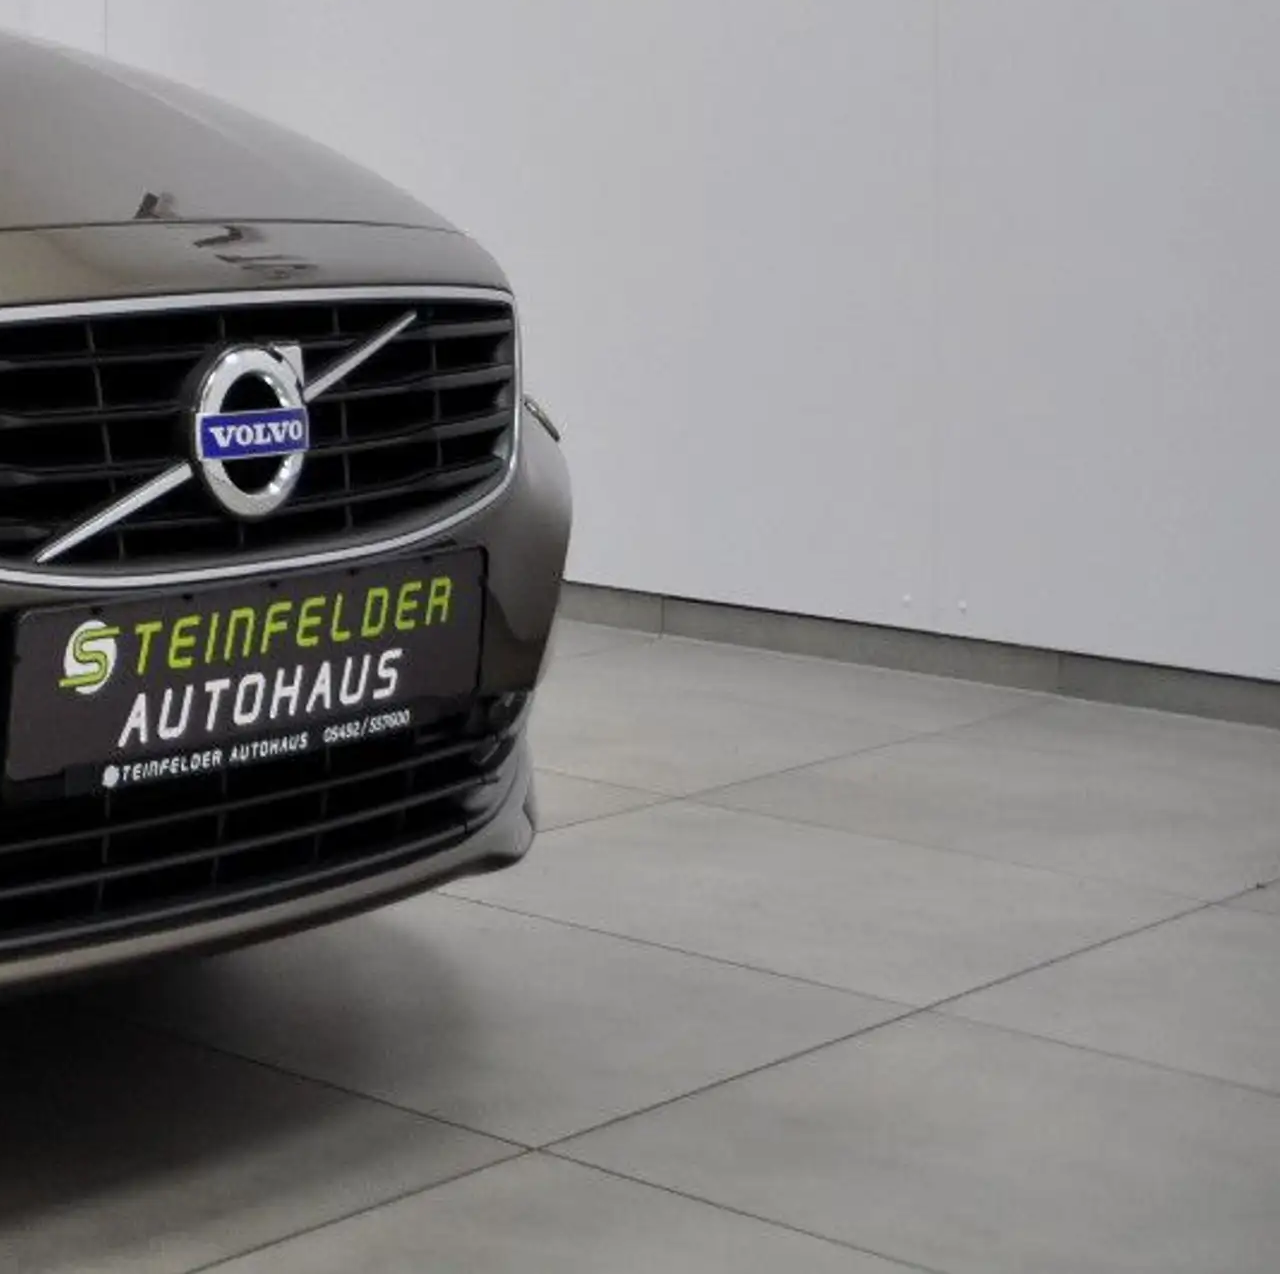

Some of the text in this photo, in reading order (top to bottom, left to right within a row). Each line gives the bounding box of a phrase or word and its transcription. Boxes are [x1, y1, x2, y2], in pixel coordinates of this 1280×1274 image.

[208, 417, 304, 449] VOLVO
[59, 576, 453, 689] STEINFELDER
[117, 648, 403, 747] AUTOHAUS
[102, 749, 223, 788] TEINFELDER
[228, 731, 309, 764] AUTOHAUS
